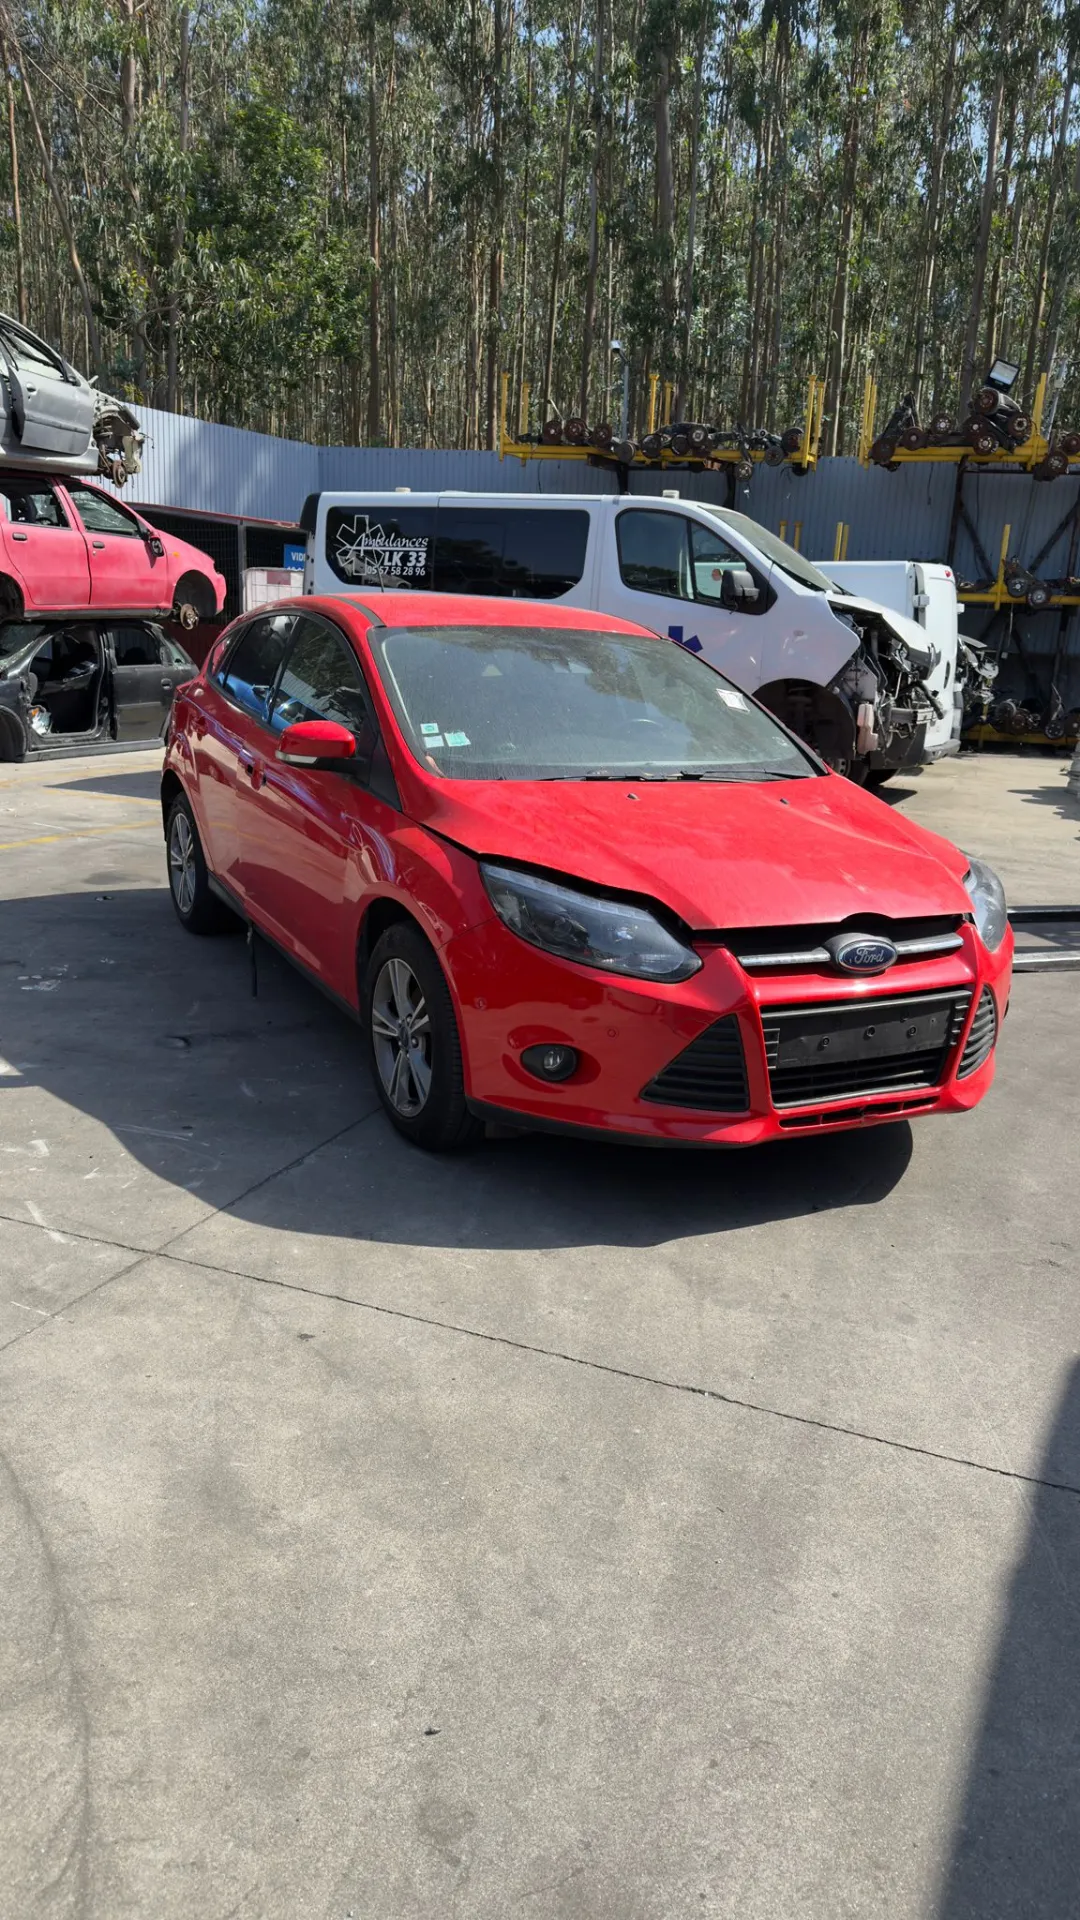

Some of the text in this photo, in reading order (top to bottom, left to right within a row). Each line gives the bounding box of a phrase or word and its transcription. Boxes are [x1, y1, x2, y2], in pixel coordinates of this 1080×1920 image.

[346, 532, 429, 557] Ambulances
[383, 551, 427, 567] LK 33
[367, 566, 378, 575] 05
[390, 566, 402, 576] 58
[402, 567, 414, 576] 28
[415, 567, 426, 577] 96
[854, 946, 884, 965] Ford
